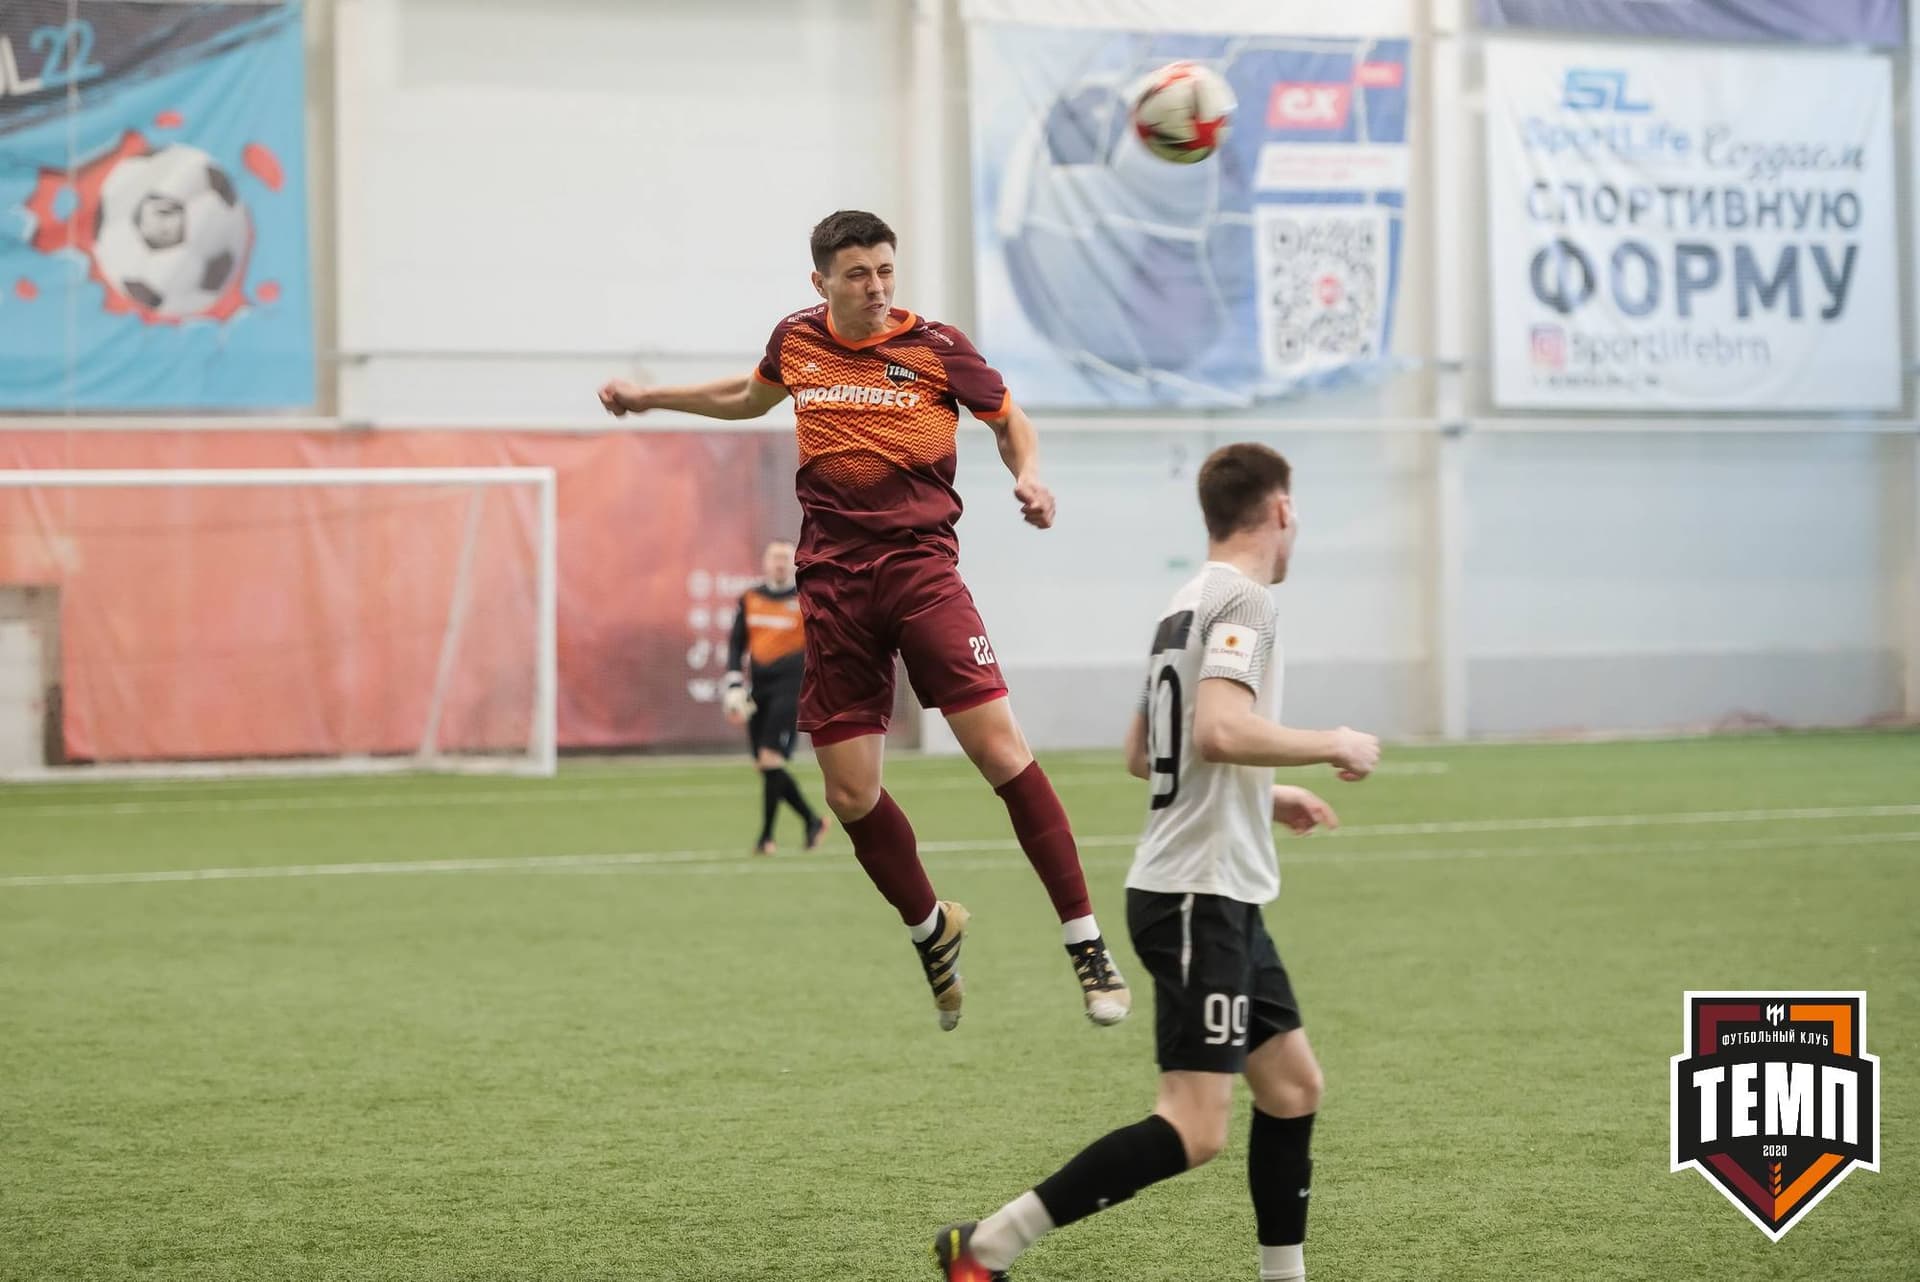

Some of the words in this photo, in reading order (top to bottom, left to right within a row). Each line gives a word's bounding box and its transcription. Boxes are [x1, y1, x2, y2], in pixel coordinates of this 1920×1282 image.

[1563, 68, 1654, 114] SL
[1527, 181, 1863, 231] СПОРТИВНУЮ
[1528, 237, 1861, 322] ФОРМУ
[889, 365, 916, 380] ТЕМП
[797, 384, 920, 408] ПРОДИНВЕСТ
[969, 635, 995, 666] 22
[1204, 993, 1249, 1046] 99
